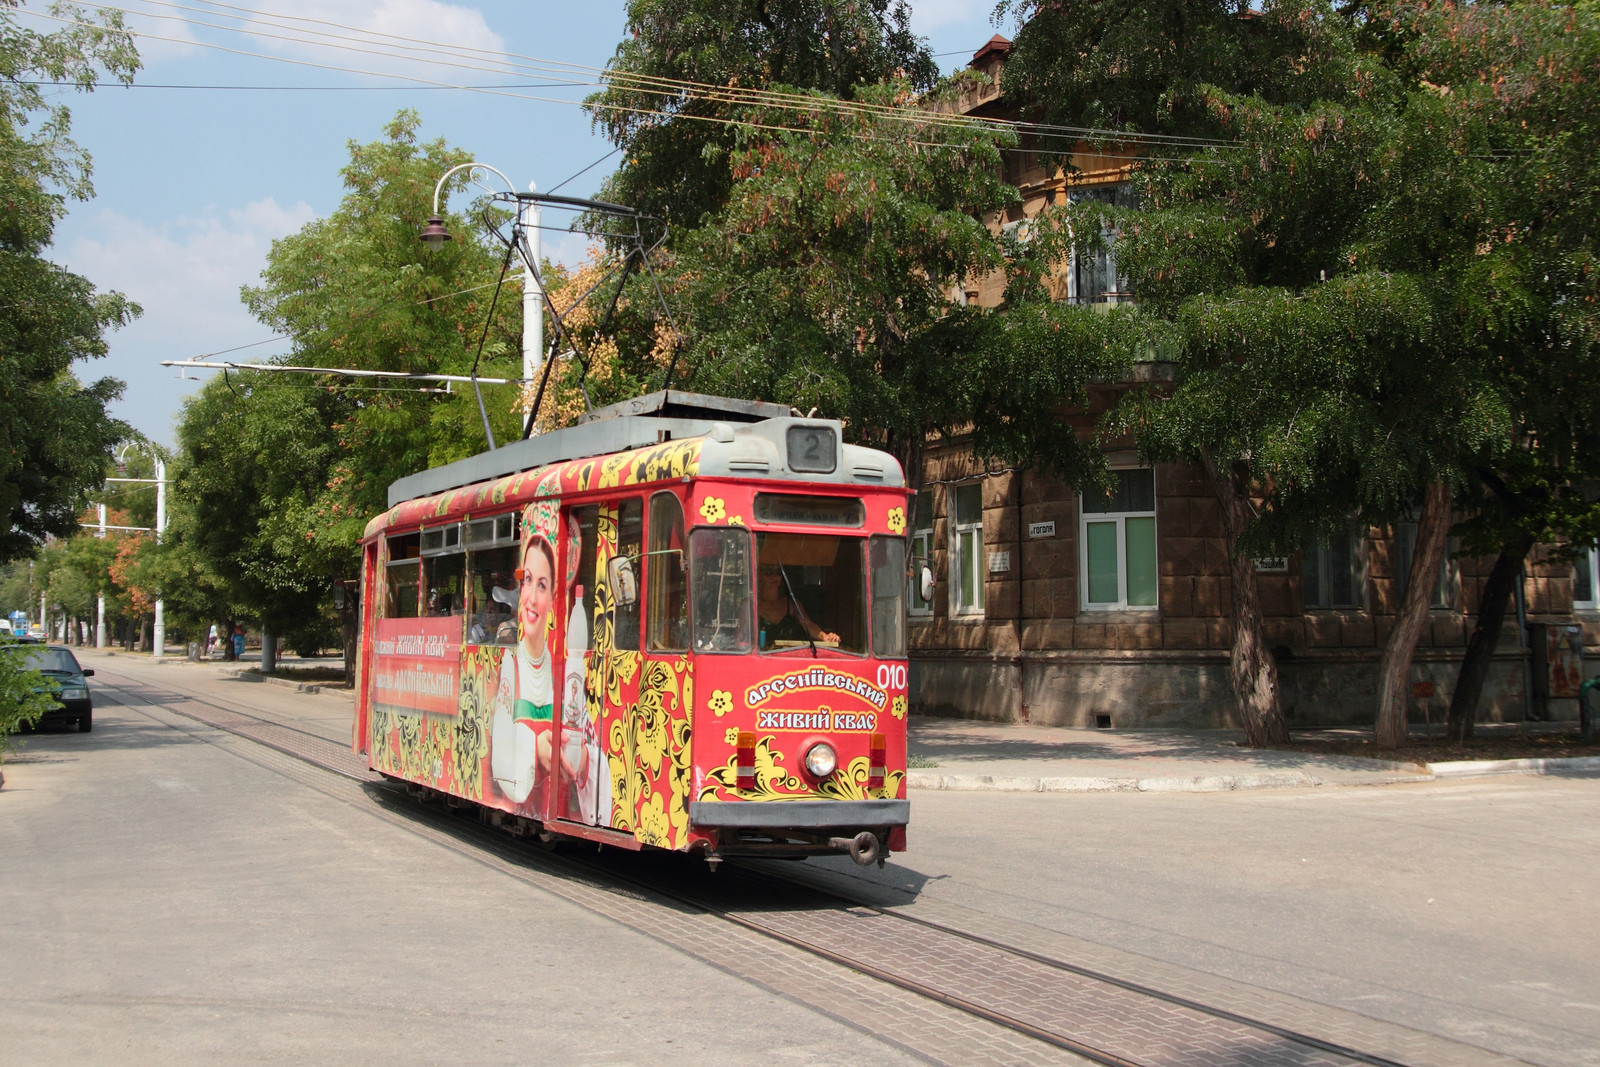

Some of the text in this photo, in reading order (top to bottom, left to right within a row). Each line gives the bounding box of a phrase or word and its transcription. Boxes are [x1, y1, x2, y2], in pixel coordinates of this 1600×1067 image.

[804, 434, 820, 460] 2
[1033, 525, 1053, 535] ГОГОЛЯ
[748, 669, 886, 708] АРСЕНІЇВСЬКИЙ
[877, 664, 906, 690] 010
[759, 708, 875, 730] ЖИВИЙ КВАС
